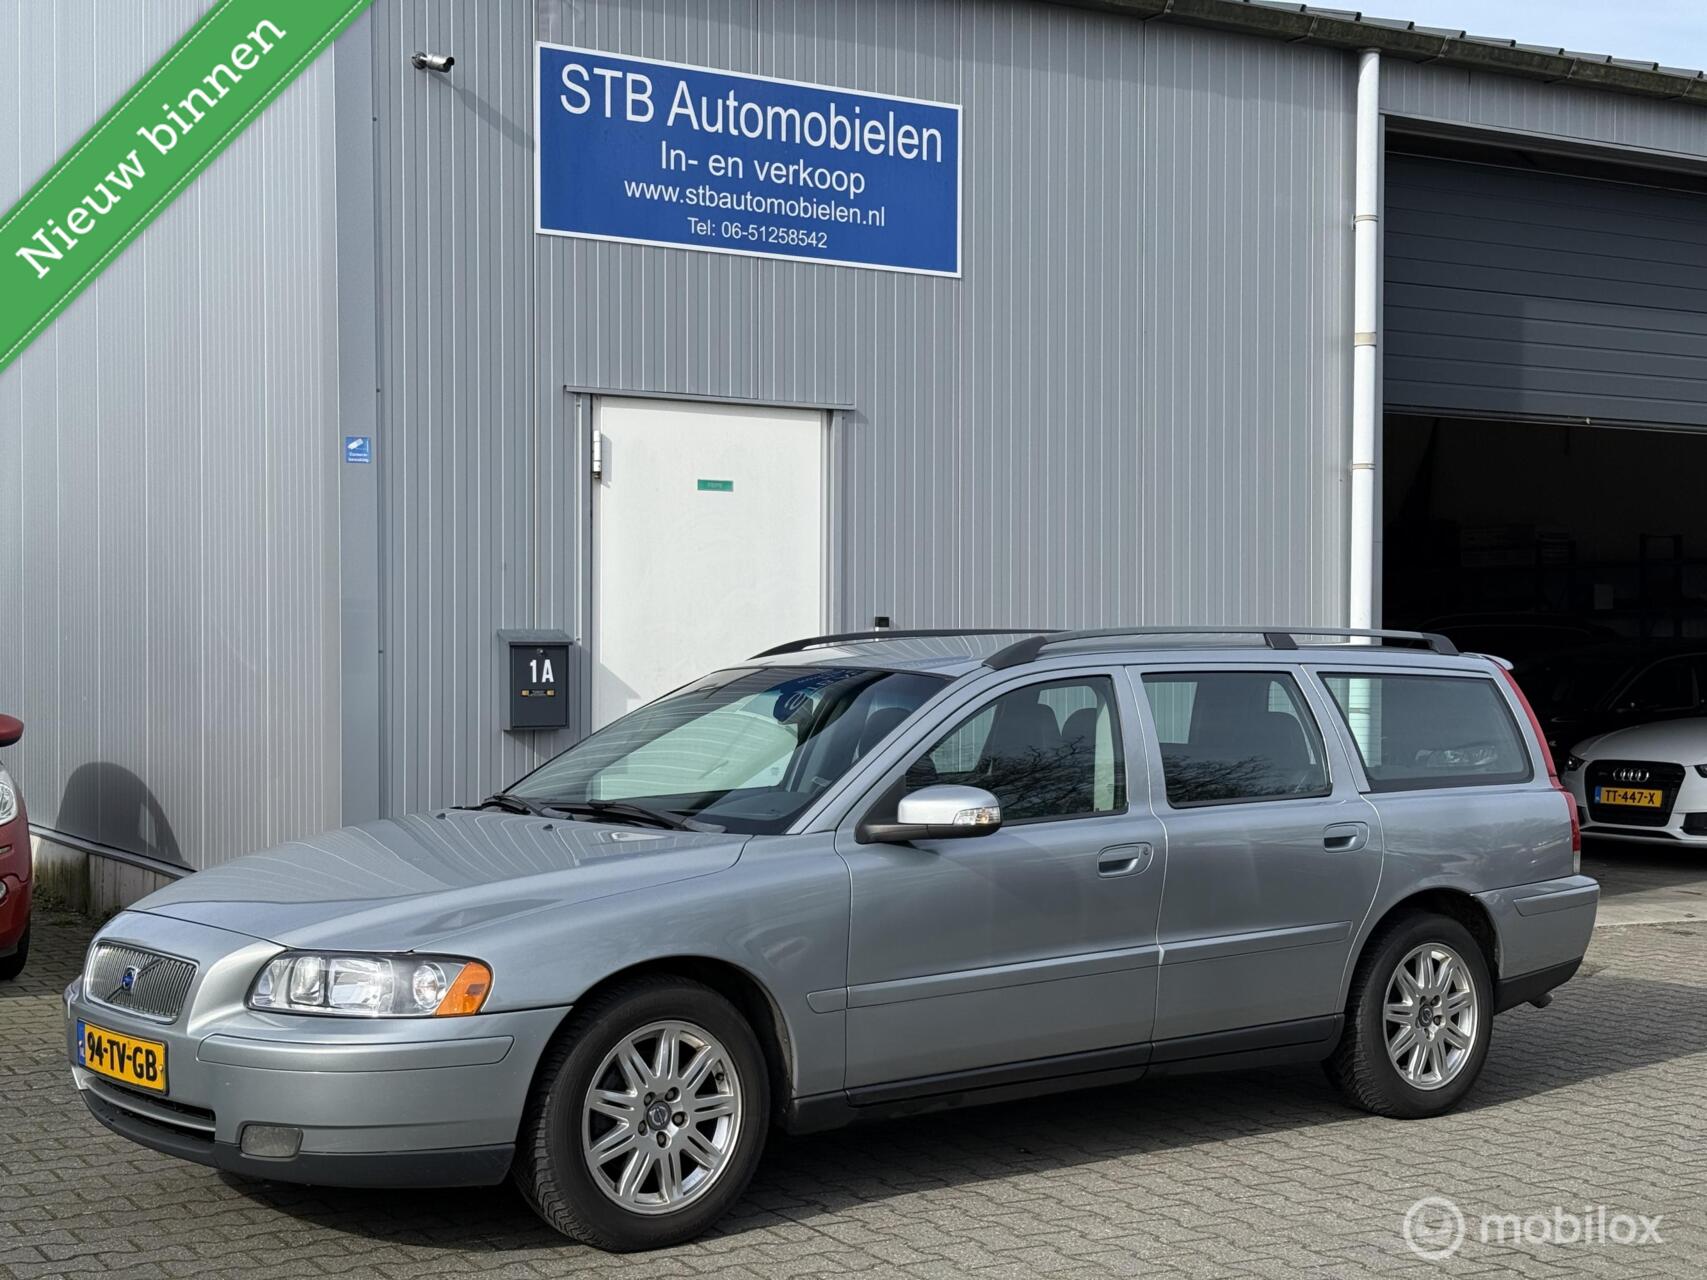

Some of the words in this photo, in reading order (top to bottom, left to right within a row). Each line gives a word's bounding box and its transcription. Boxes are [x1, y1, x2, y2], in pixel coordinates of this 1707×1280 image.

[560, 63, 655, 123] STB
[667, 80, 942, 163] Automobielen
[660, 140, 698, 171] In-
[708, 154, 743, 179] en
[754, 160, 865, 194] verkoop
[624, 180, 885, 227] www.stbautomobielen.nl
[687, 217, 716, 237] Tel:
[721, 222, 828, 249] 06-51258542
[1605, 790, 1656, 805] TT-447-X
[87, 1031, 158, 1082] 94-TV-GB
